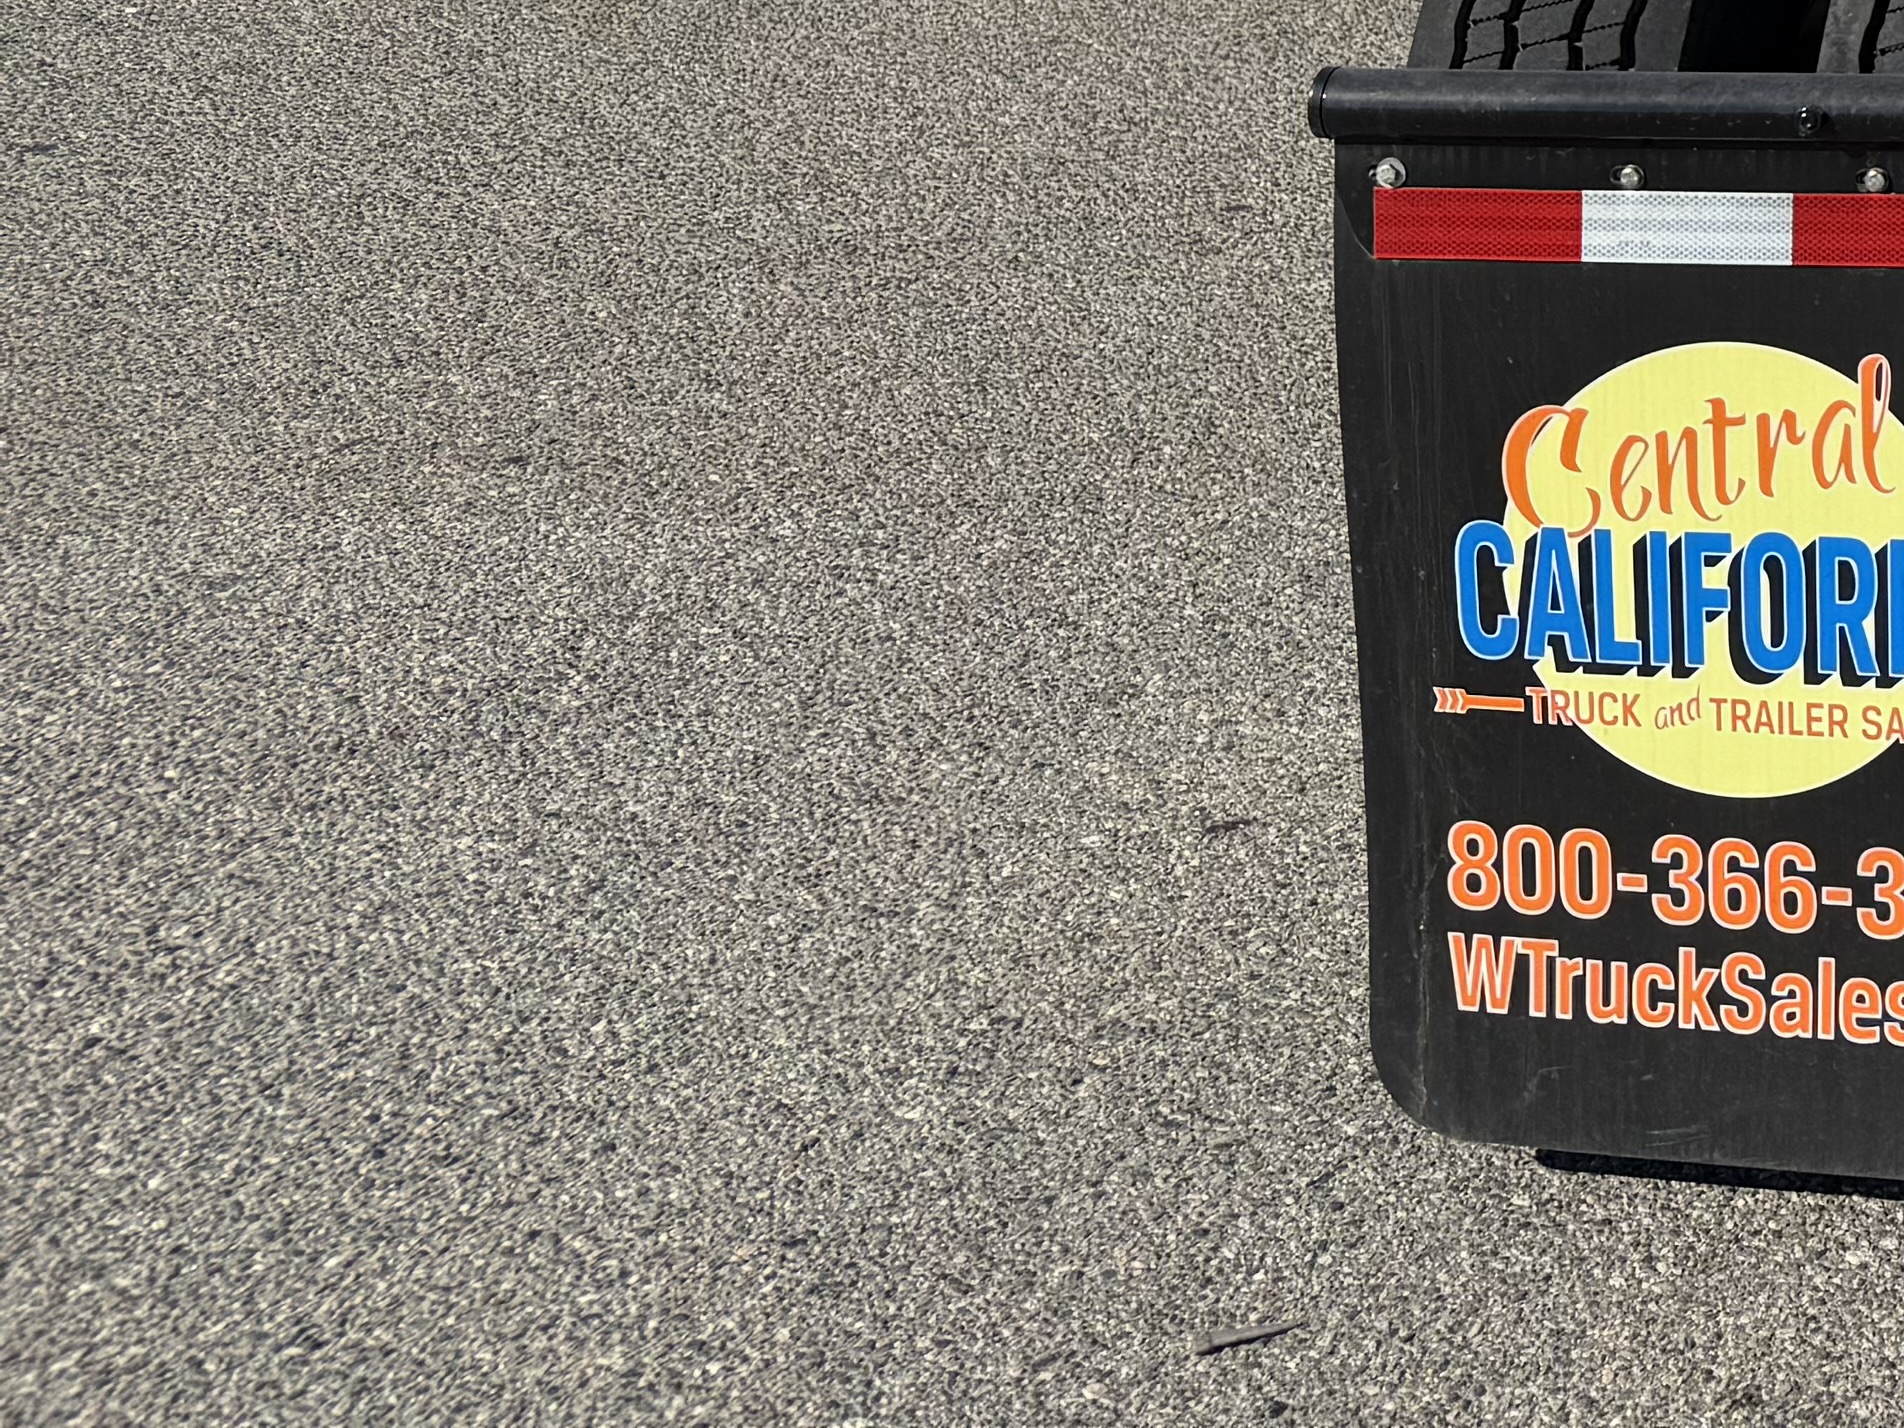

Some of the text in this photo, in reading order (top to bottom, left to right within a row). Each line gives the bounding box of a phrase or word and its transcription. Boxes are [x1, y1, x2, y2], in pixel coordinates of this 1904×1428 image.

[1502, 353, 1897, 538] Central
[1524, 685, 1643, 730] TRUCK
[1653, 686, 1703, 734] and
[1709, 696, 1850, 741] TRAILER
